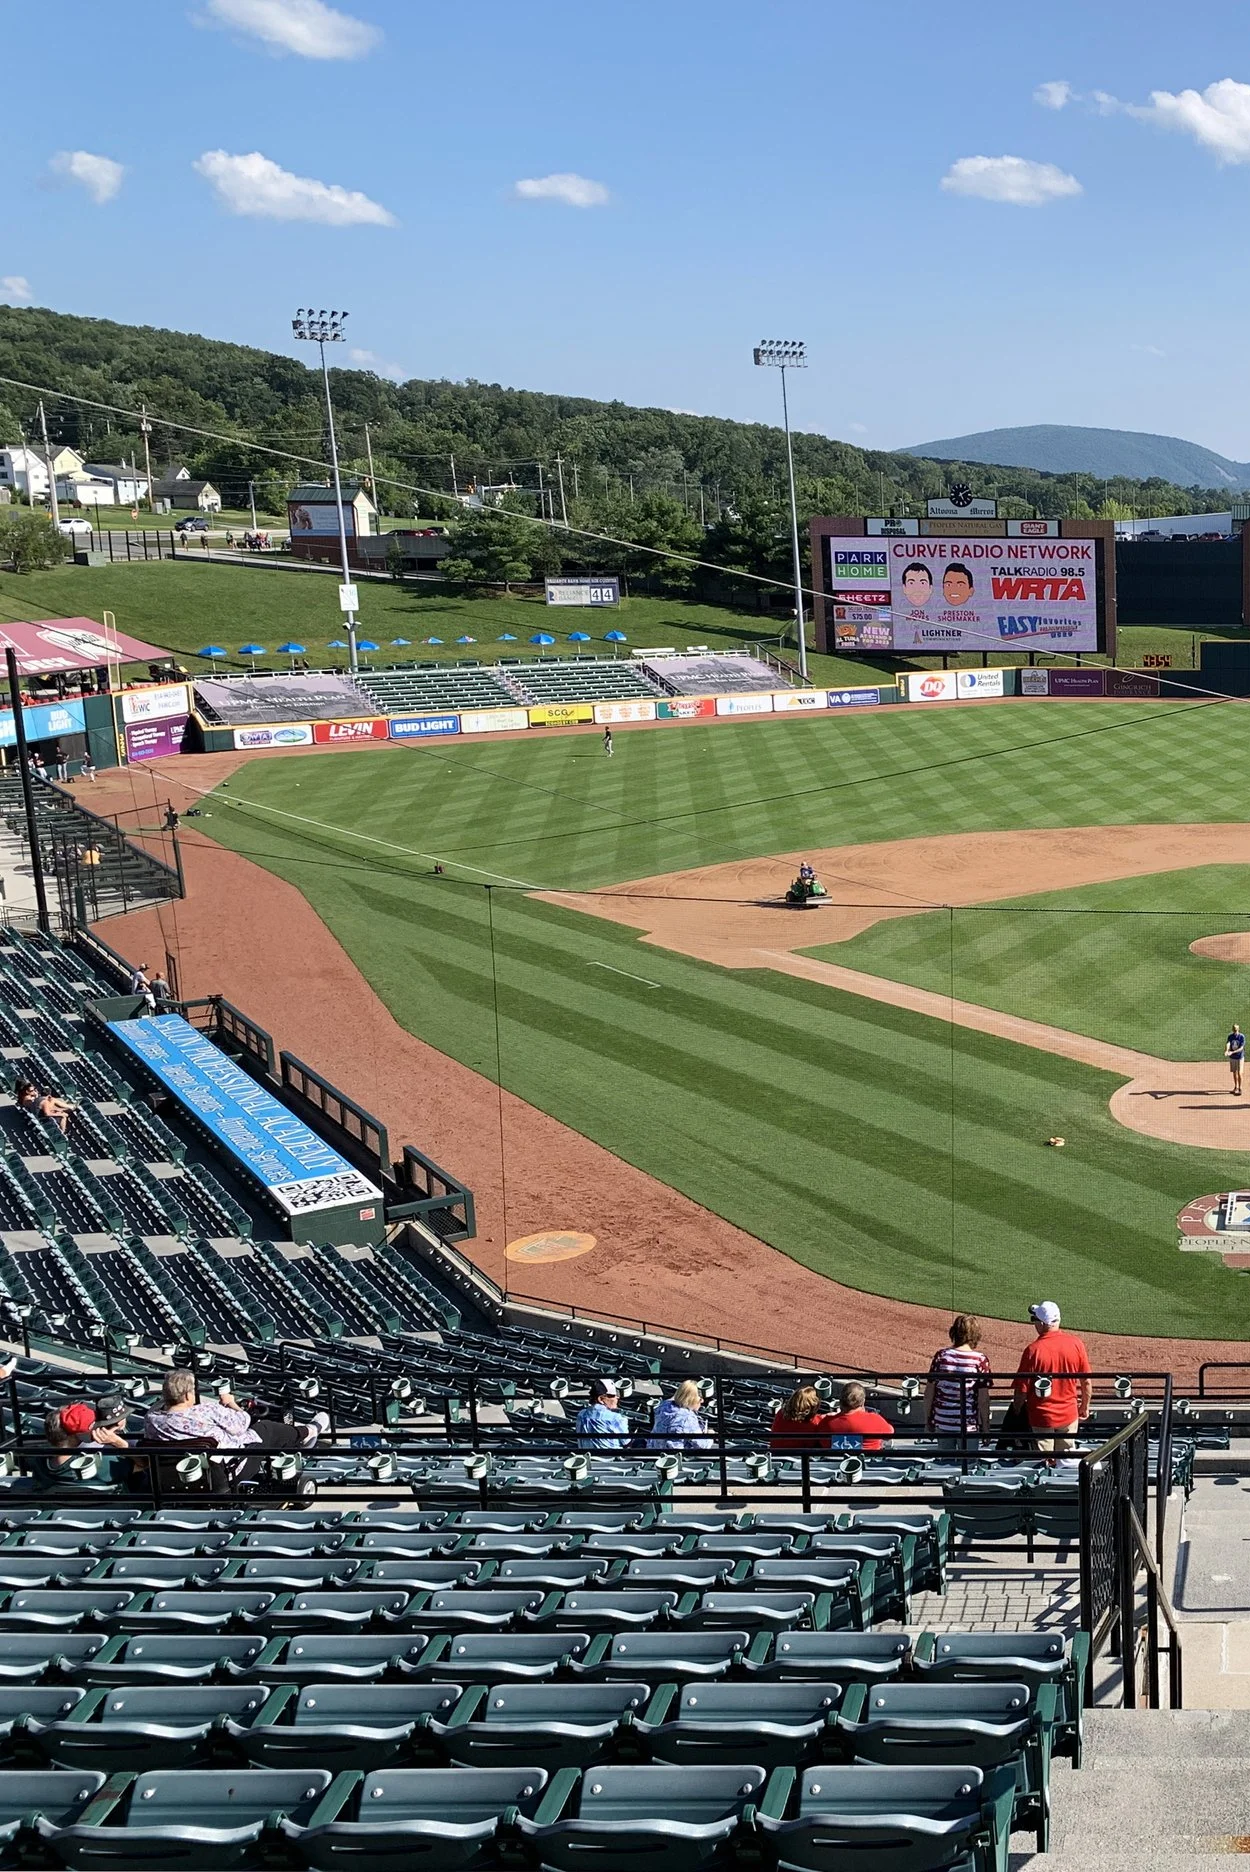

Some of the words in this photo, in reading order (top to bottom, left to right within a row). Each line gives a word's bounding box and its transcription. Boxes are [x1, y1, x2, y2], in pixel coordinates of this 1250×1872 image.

[929, 507, 958, 516] Altoona
[970, 507, 994, 516] Mirror
[957, 521, 987, 529] NATURAL
[881, 527, 906, 535] DISPOSAL
[893, 544, 947, 558] CURVE
[951, 544, 1003, 558] RADIO
[1008, 545, 1092, 560] NETWORK
[837, 553, 885, 563] PARK
[837, 566, 885, 576] HOME
[991, 566, 1058, 577] TALKRADIO
[1061, 567, 1085, 577] 98.5
[991, 578, 1086, 601] WRTA
[862, 626, 890, 635] NEW
[997, 616, 1038, 636] EASY
[1039, 617, 1082, 626] favorites
[922, 629, 962, 637] LIGHTNER
[977, 673, 999, 681] United
[924, 681, 943, 692] DQ
[830, 695, 842, 703] VA
[48, 718, 72, 731] LIGHT
[329, 722, 374, 737] LEVIN
[394, 722, 420, 733] BUD
[420, 719, 455, 732] LIGHT
[160, 1019, 199, 1047] SALON
[181, 1044, 281, 1121] PROFESSIONAL
[258, 1115, 346, 1170] ACADEMY
[134, 1038, 170, 1060] Careers
[183, 1085, 225, 1113] Students
[246, 1149, 297, 1183] Services
